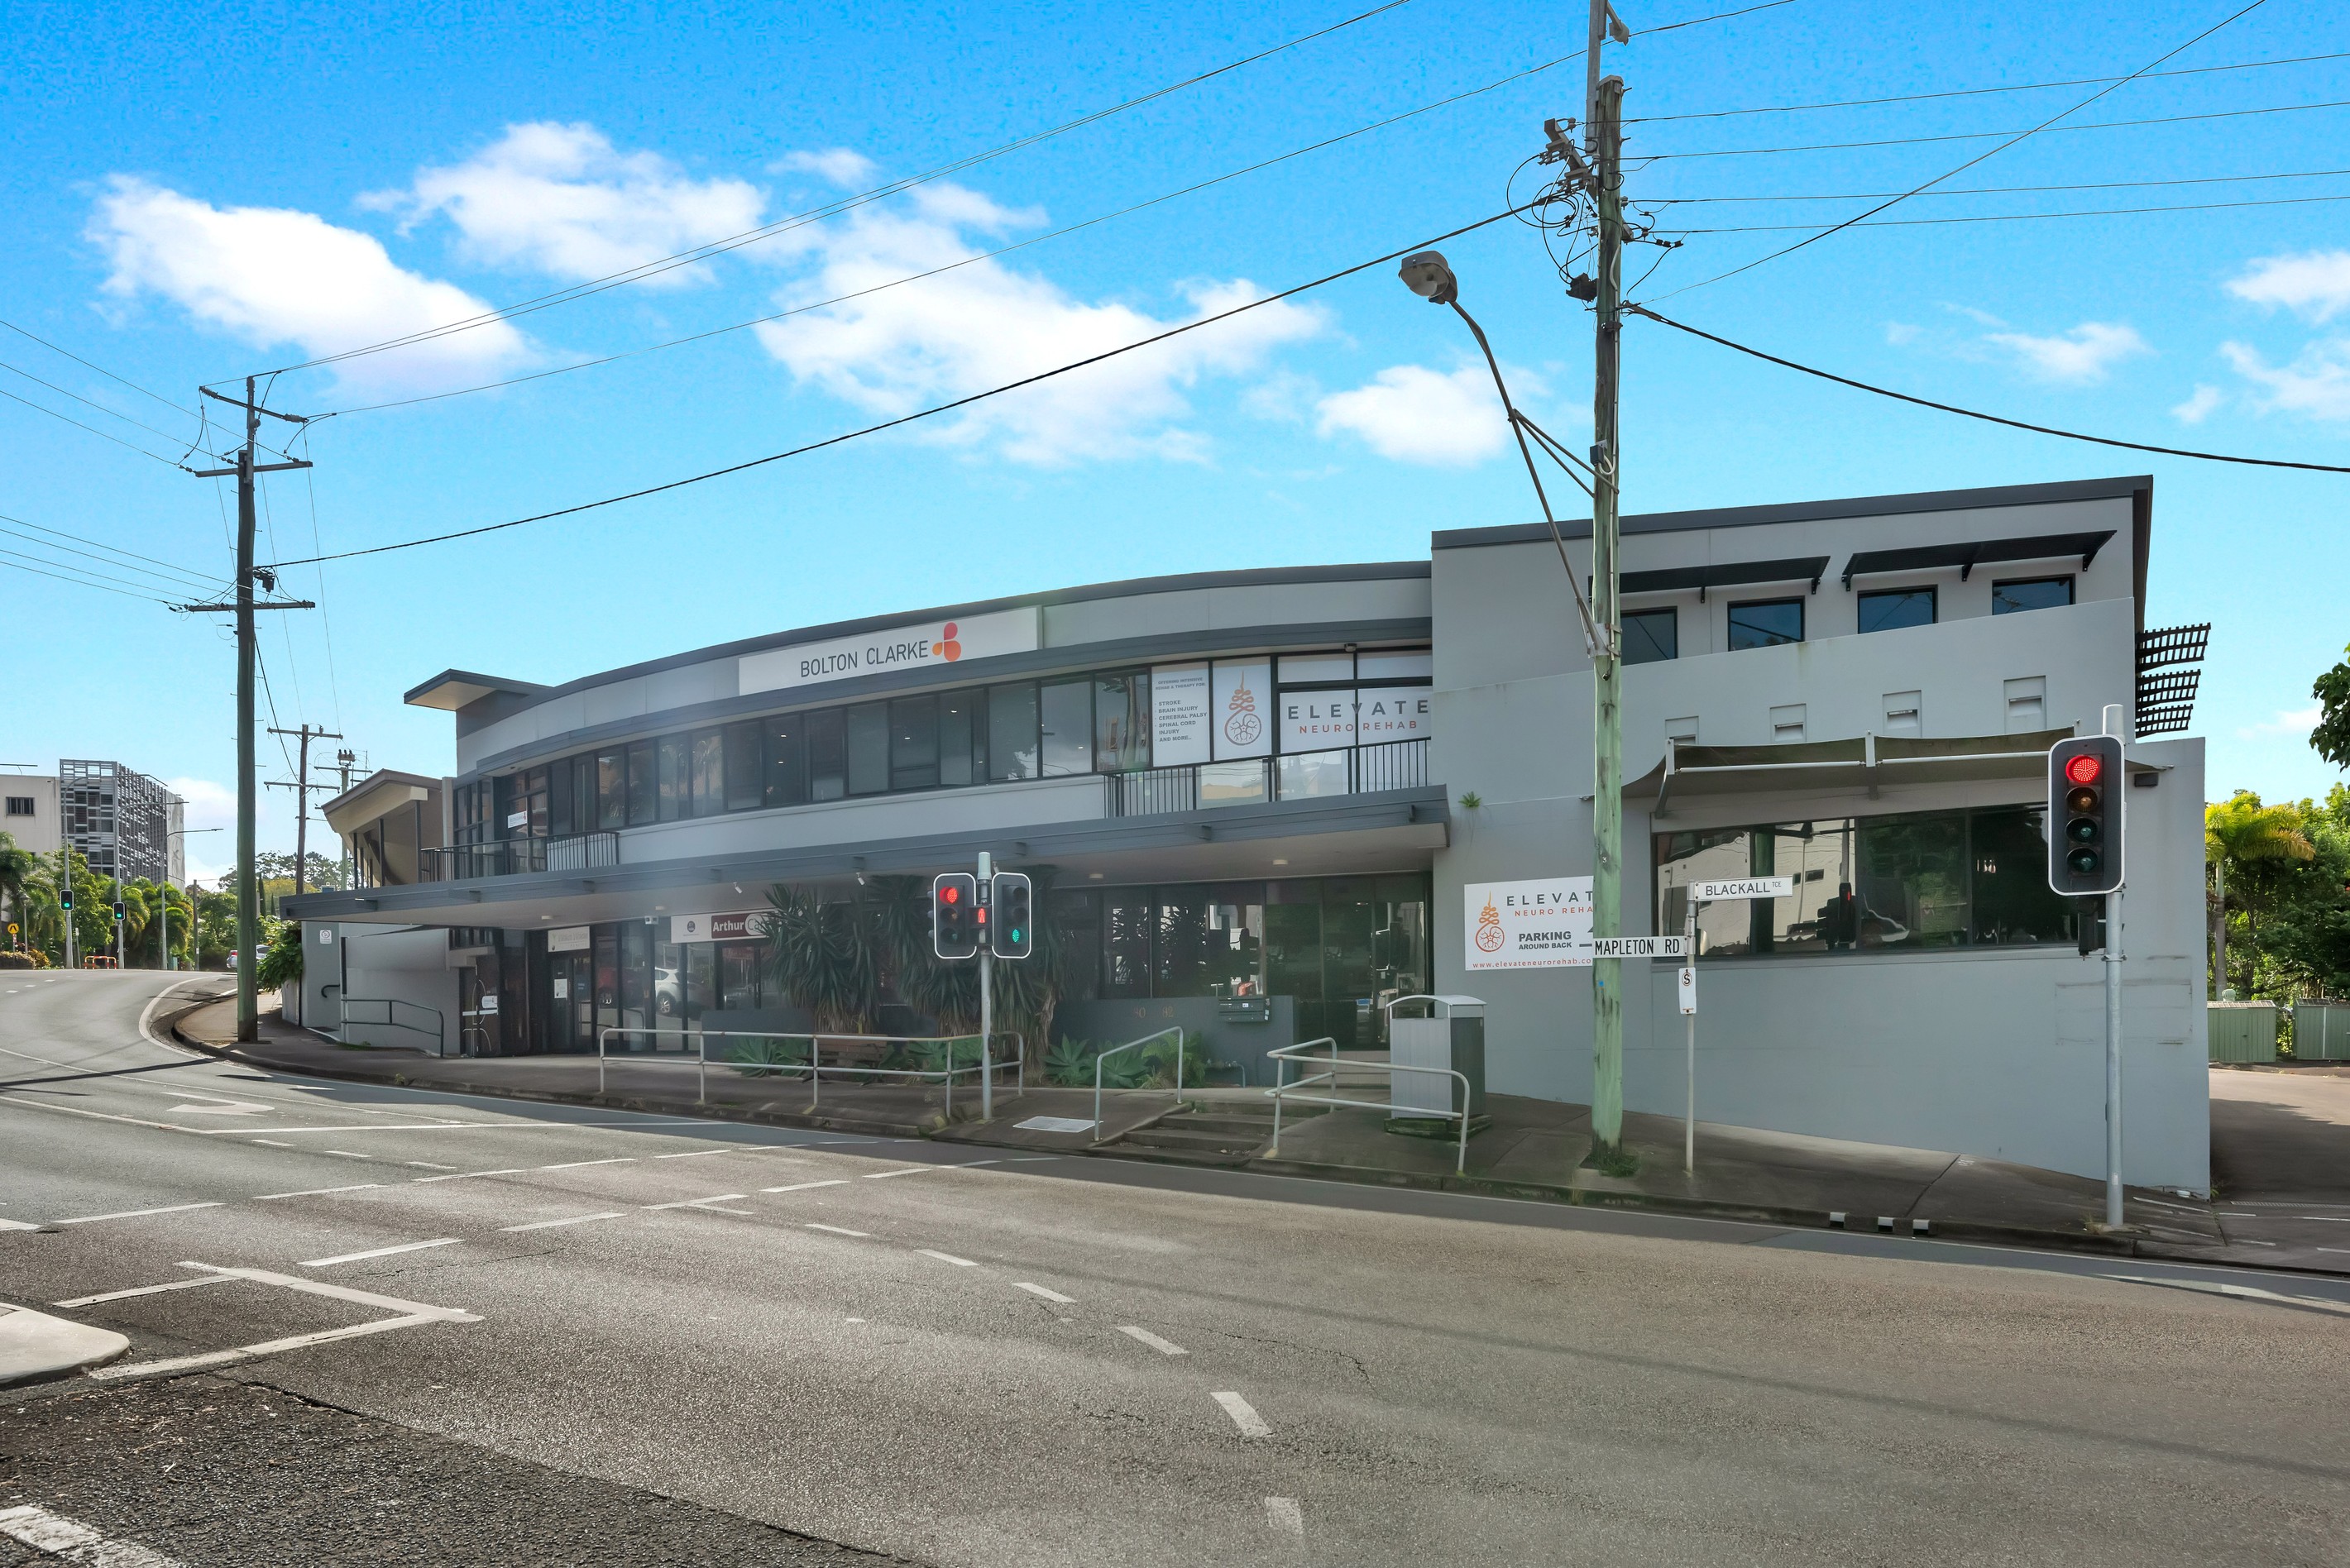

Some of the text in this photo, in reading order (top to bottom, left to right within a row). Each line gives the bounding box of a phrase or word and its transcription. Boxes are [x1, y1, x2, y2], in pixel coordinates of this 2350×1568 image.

[800, 640, 929, 678] BOLTON CLARKE
[1288, 700, 1429, 719] ELEVATE
[1299, 720, 1417, 734] NEURO REHAB
[1705, 882, 1771, 896] BLACKALL
[1506, 891, 1593, 906] ELEVAT
[1515, 908, 1554, 916] NEURO
[712, 920, 744, 932] Arthur
[1519, 931, 1572, 942] PARKING
[1595, 939, 1680, 955] MAPLETON RD
[1472, 958, 1591, 968] www.elevateneurorehab.co
